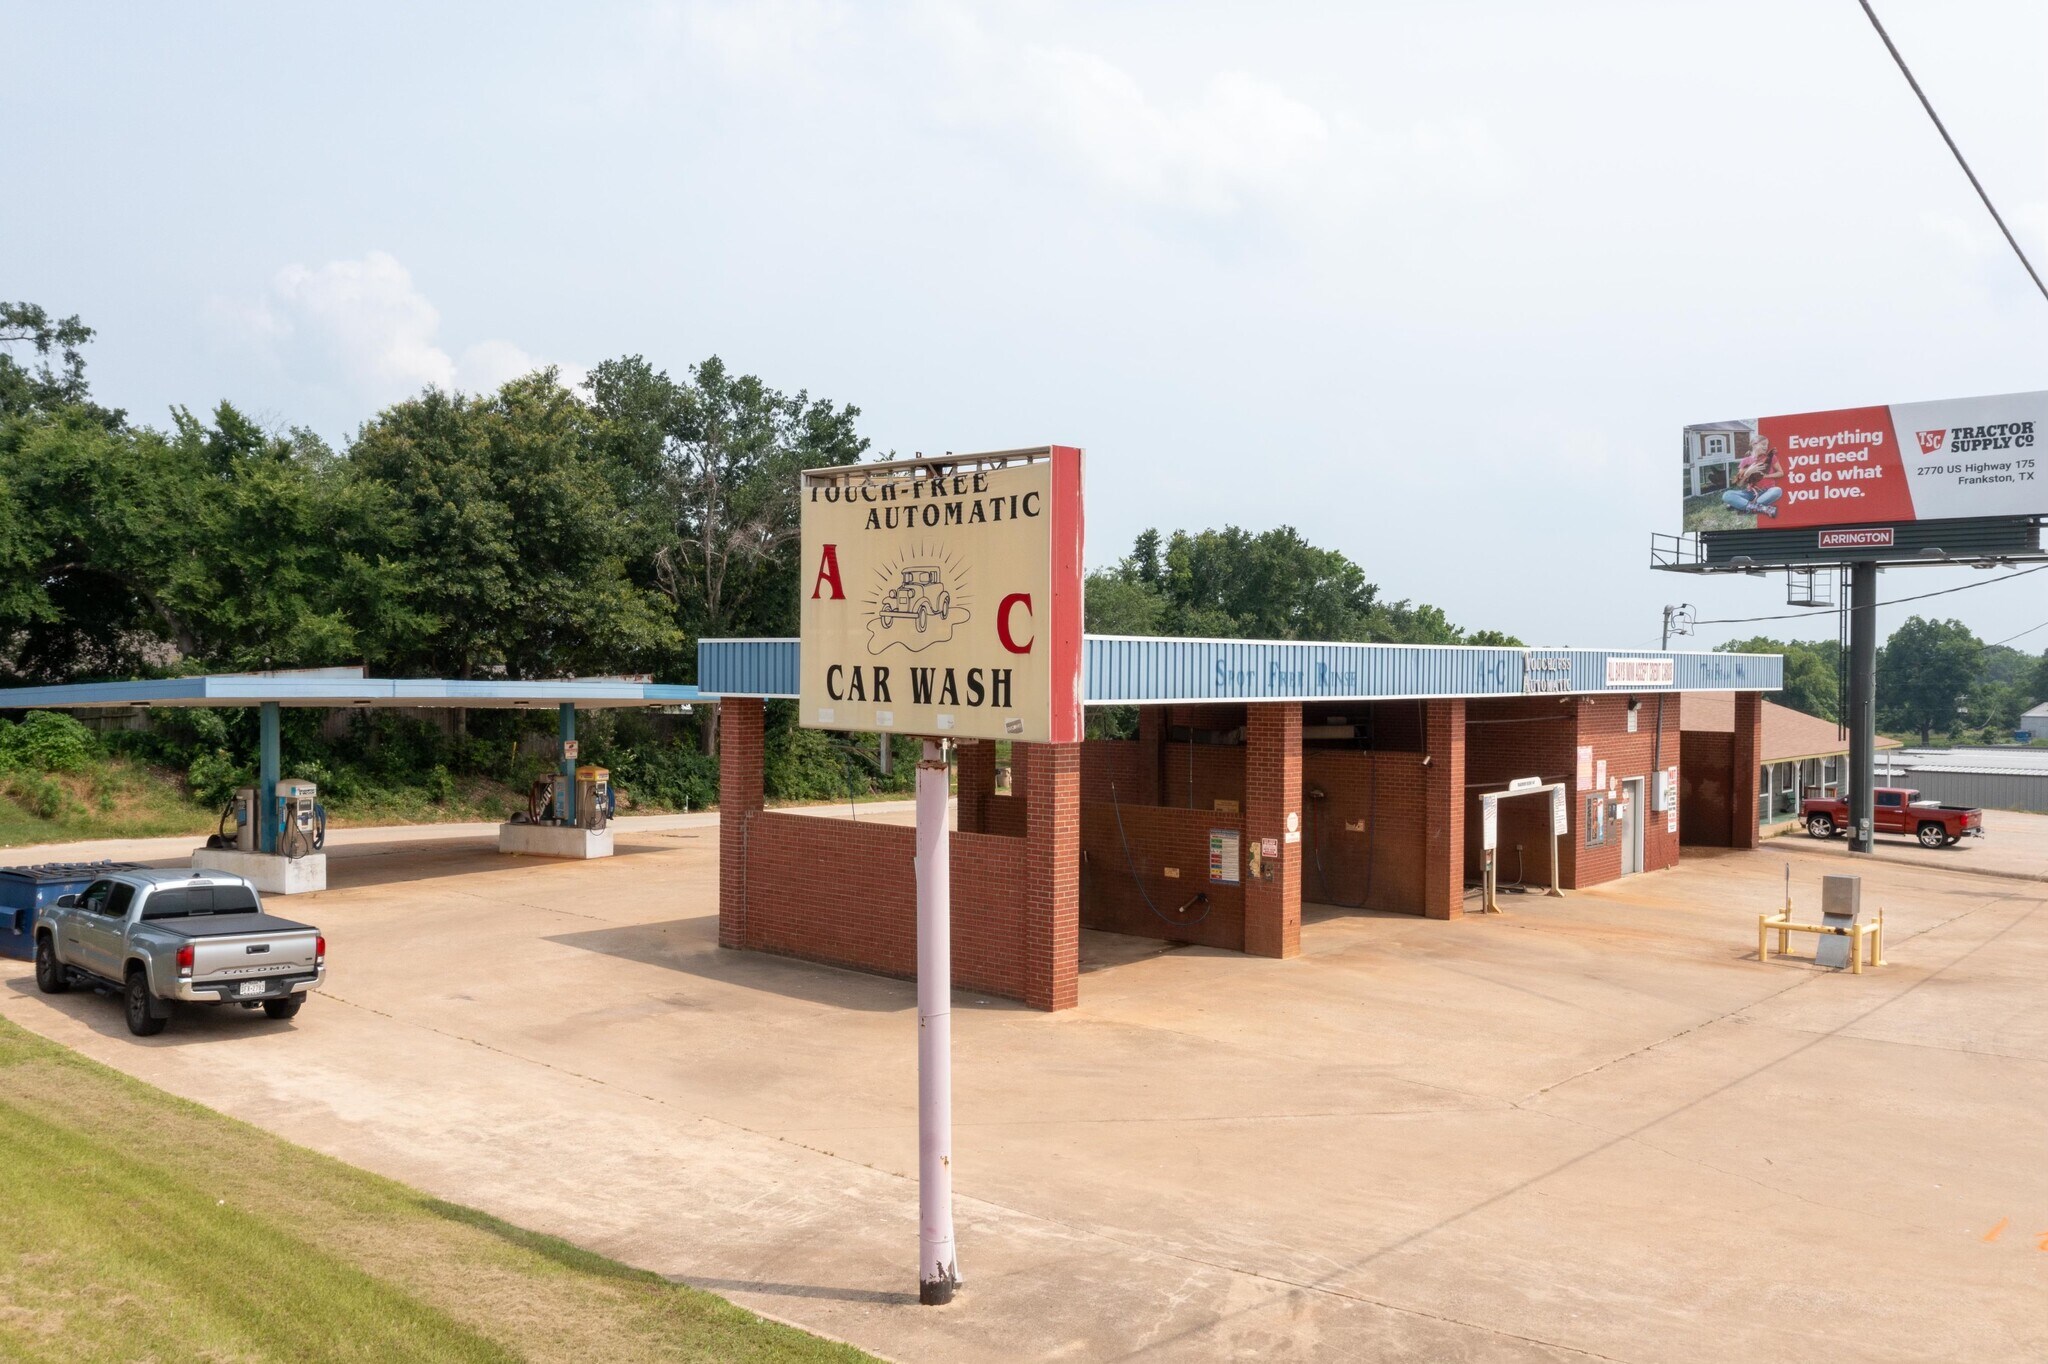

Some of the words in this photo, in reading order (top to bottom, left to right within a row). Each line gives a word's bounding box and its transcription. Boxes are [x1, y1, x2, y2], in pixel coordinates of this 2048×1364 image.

[1789, 428, 1883, 450] Everything
[1951, 421, 2034, 440] TRACTOR
[1919, 432, 1941, 450] TSC
[1951, 437, 2012, 453] SUPPLY
[1788, 454, 1819, 470] you
[1825, 447, 1868, 463] need
[1917, 466, 1944, 476] 2770
[1946, 464, 1962, 474] US
[1965, 462, 2012, 474] Highway
[2015, 459, 2035, 469] 175
[1788, 471, 1806, 484] to
[1810, 468, 1832, 482] do
[1836, 464, 1882, 481] what
[1958, 474, 2015, 485] Frankston,
[2018, 471, 2035, 481] TX
[1788, 489, 1819, 505] you
[1824, 485, 1866, 499] love.
[865, 491, 1041, 530] AUTOMATIC
[1822, 532, 1889, 545] ARRINGTON
[811, 544, 846, 600] A
[997, 592, 1035, 655] C
[826, 664, 892, 703] CAR
[910, 667, 1013, 708] WASH
[222, 965, 291, 975] TACOMA
